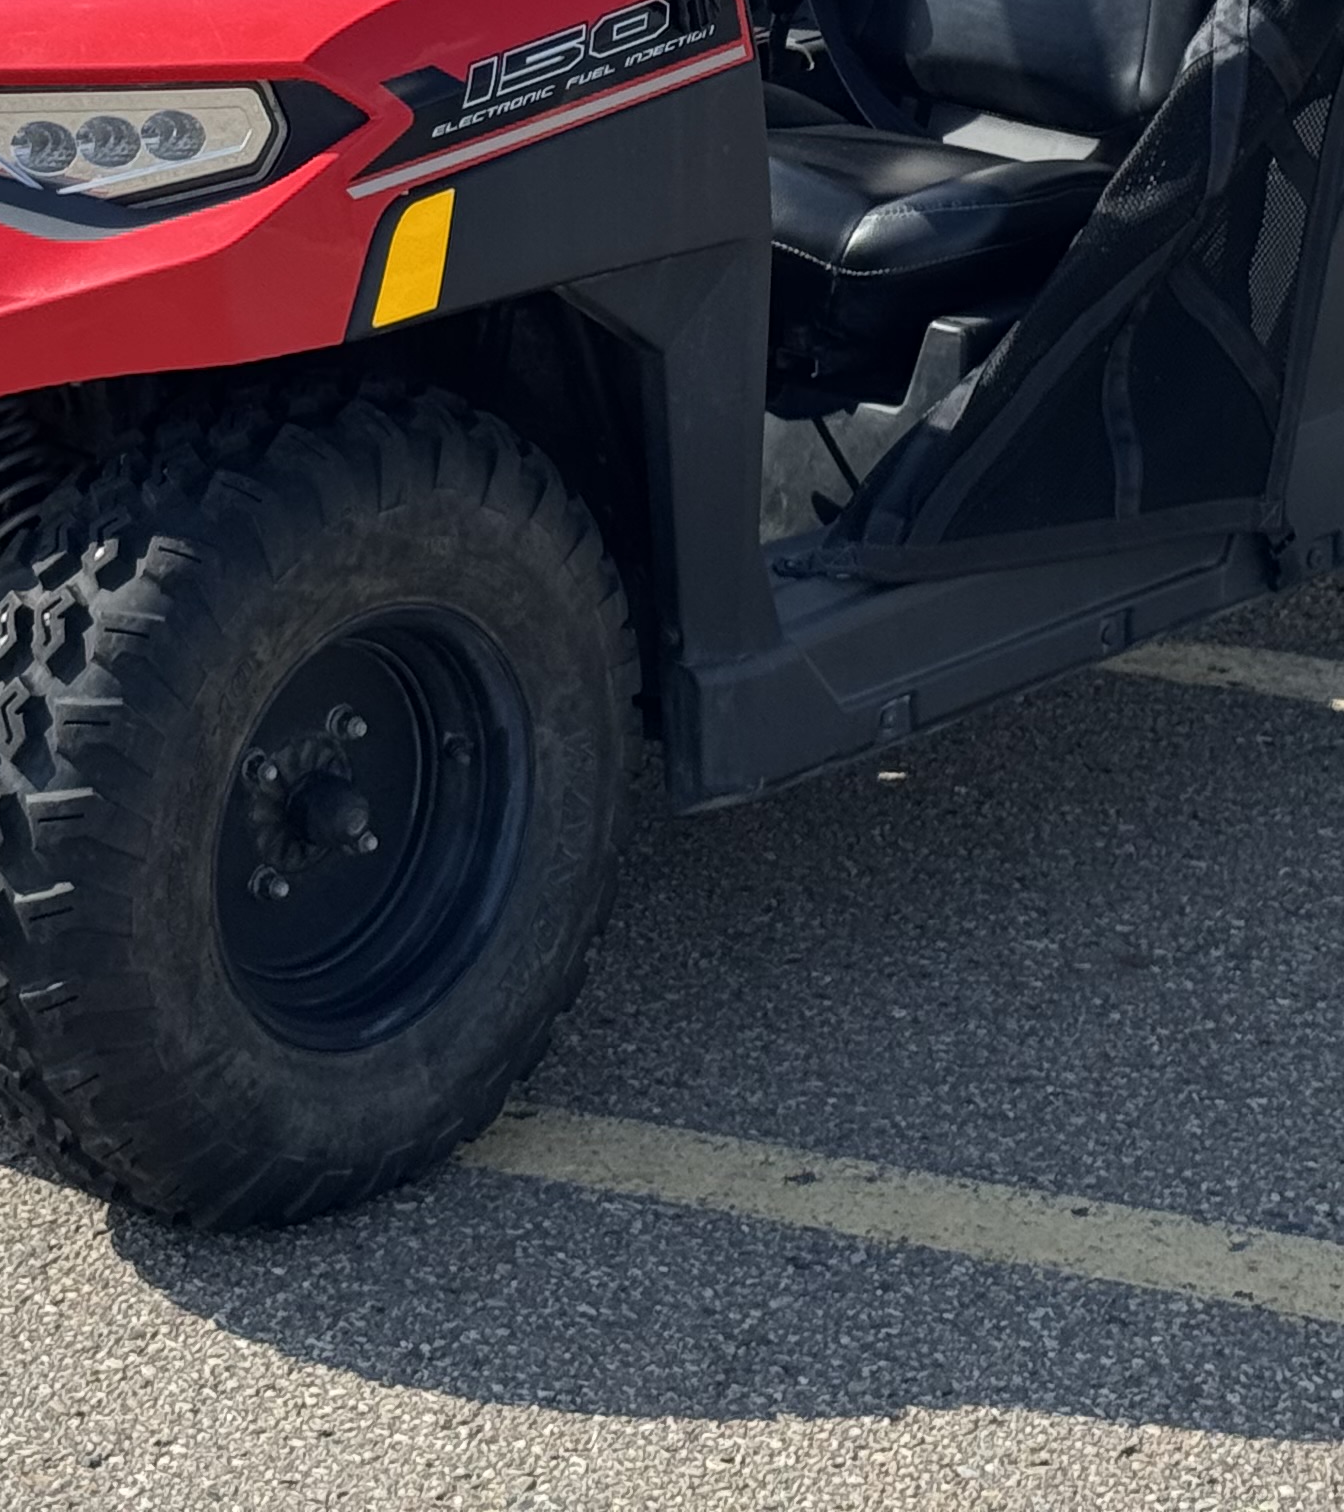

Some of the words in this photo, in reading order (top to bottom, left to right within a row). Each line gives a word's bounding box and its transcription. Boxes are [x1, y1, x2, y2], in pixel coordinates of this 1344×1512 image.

[432, 86, 556, 138] ELECTRONIC
[565, 64, 616, 90] FUEL
[624, 25, 715, 68] INJECTION
